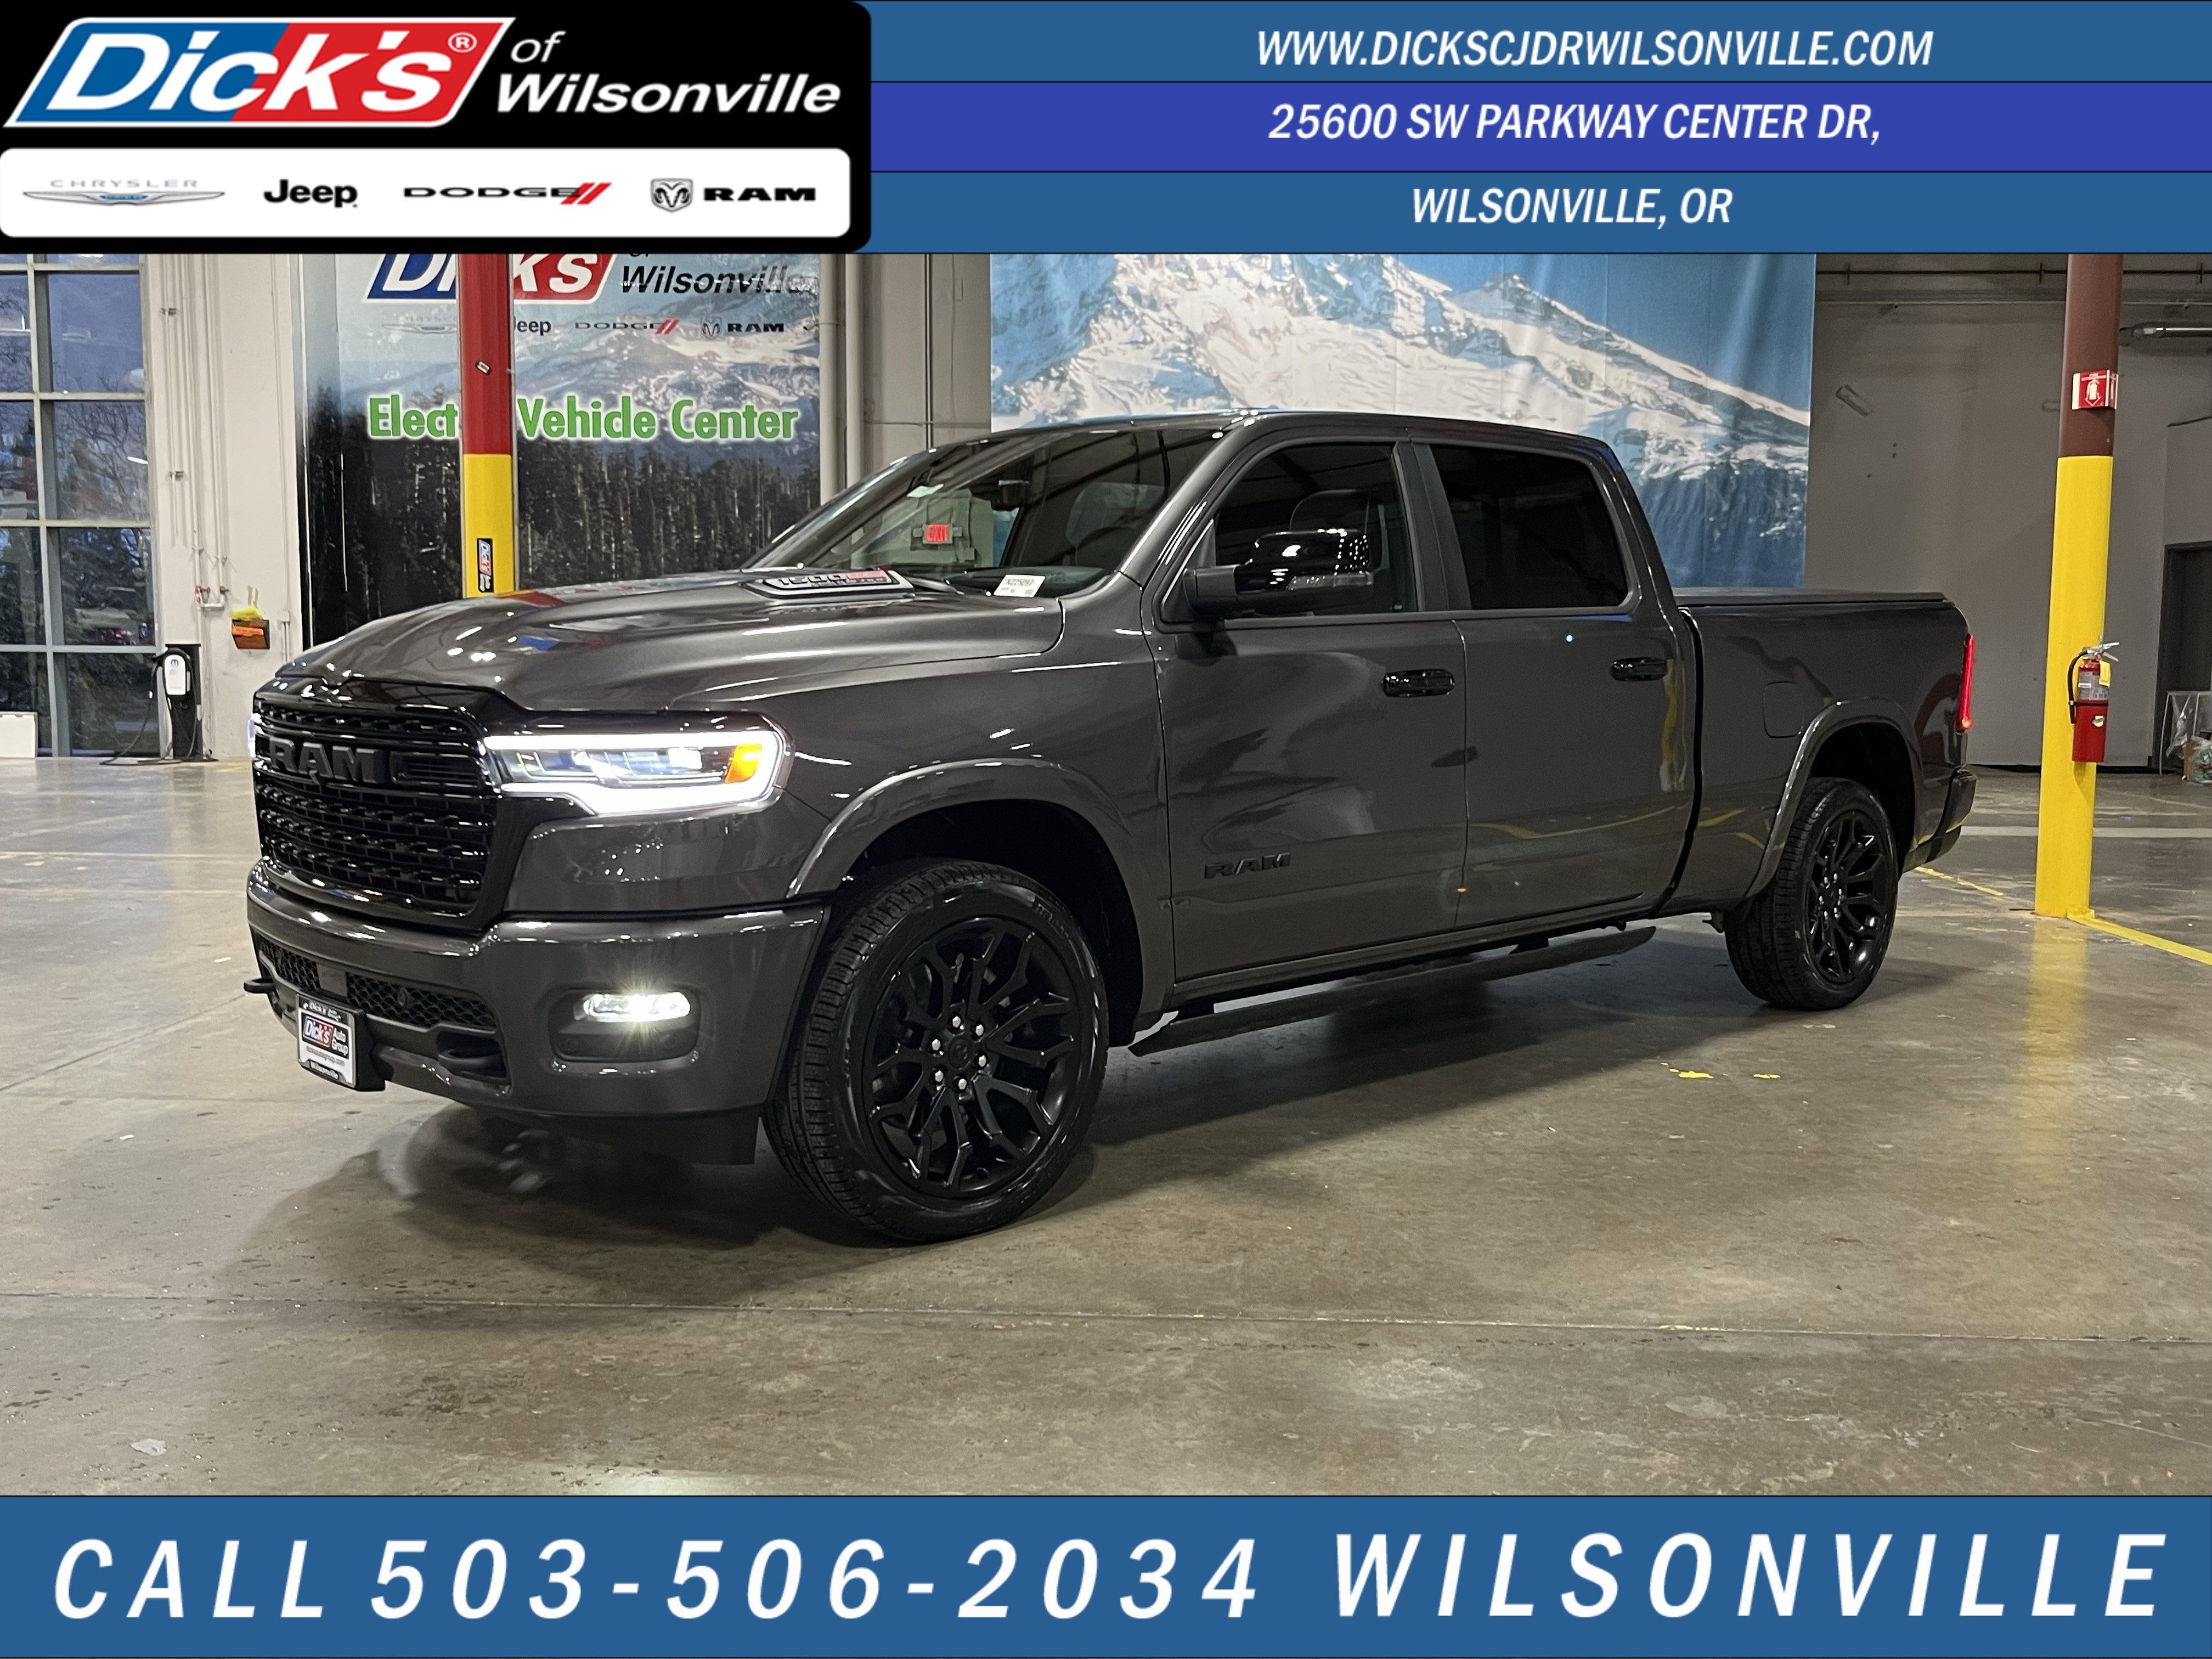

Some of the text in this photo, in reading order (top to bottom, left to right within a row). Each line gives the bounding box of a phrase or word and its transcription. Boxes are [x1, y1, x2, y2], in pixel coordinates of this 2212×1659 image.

[515, 320, 551, 336] eep
[727, 323, 785, 332] RAM
[370, 394, 798, 439] Elect Vehicle Center
[269, 736, 383, 783] RAM
[1204, 852, 1291, 879] RAM
